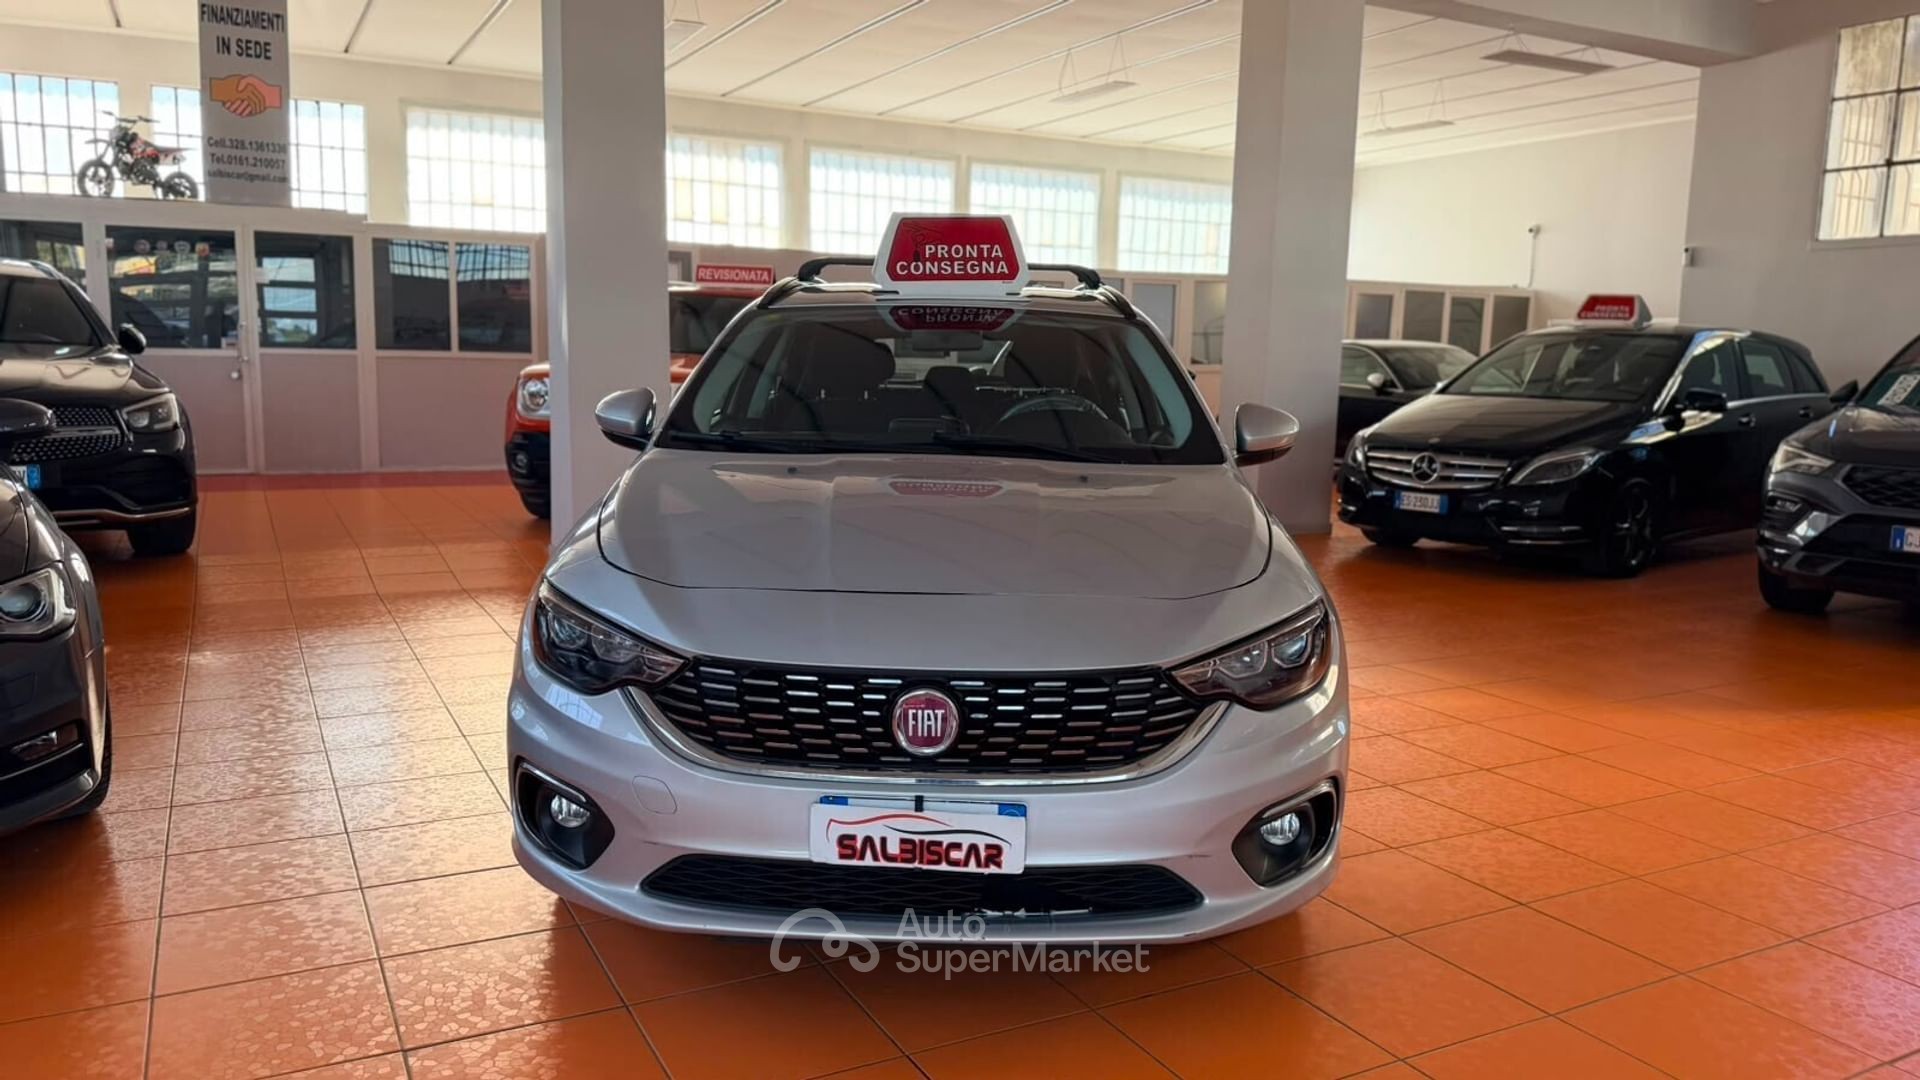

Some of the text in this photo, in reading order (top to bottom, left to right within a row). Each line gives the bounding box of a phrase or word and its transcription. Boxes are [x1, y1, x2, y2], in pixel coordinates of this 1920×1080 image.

[201, 4, 284, 32] FINANZIAMENTI
[216, 36, 272, 60] IN SEDE
[925, 244, 1003, 258] PRONTA
[698, 267, 769, 282] REVISIONATA
[896, 260, 1009, 275] CONSEGNA
[908, 709, 945, 737] FIAT
[836, 833, 1004, 869] SALBISCAR
